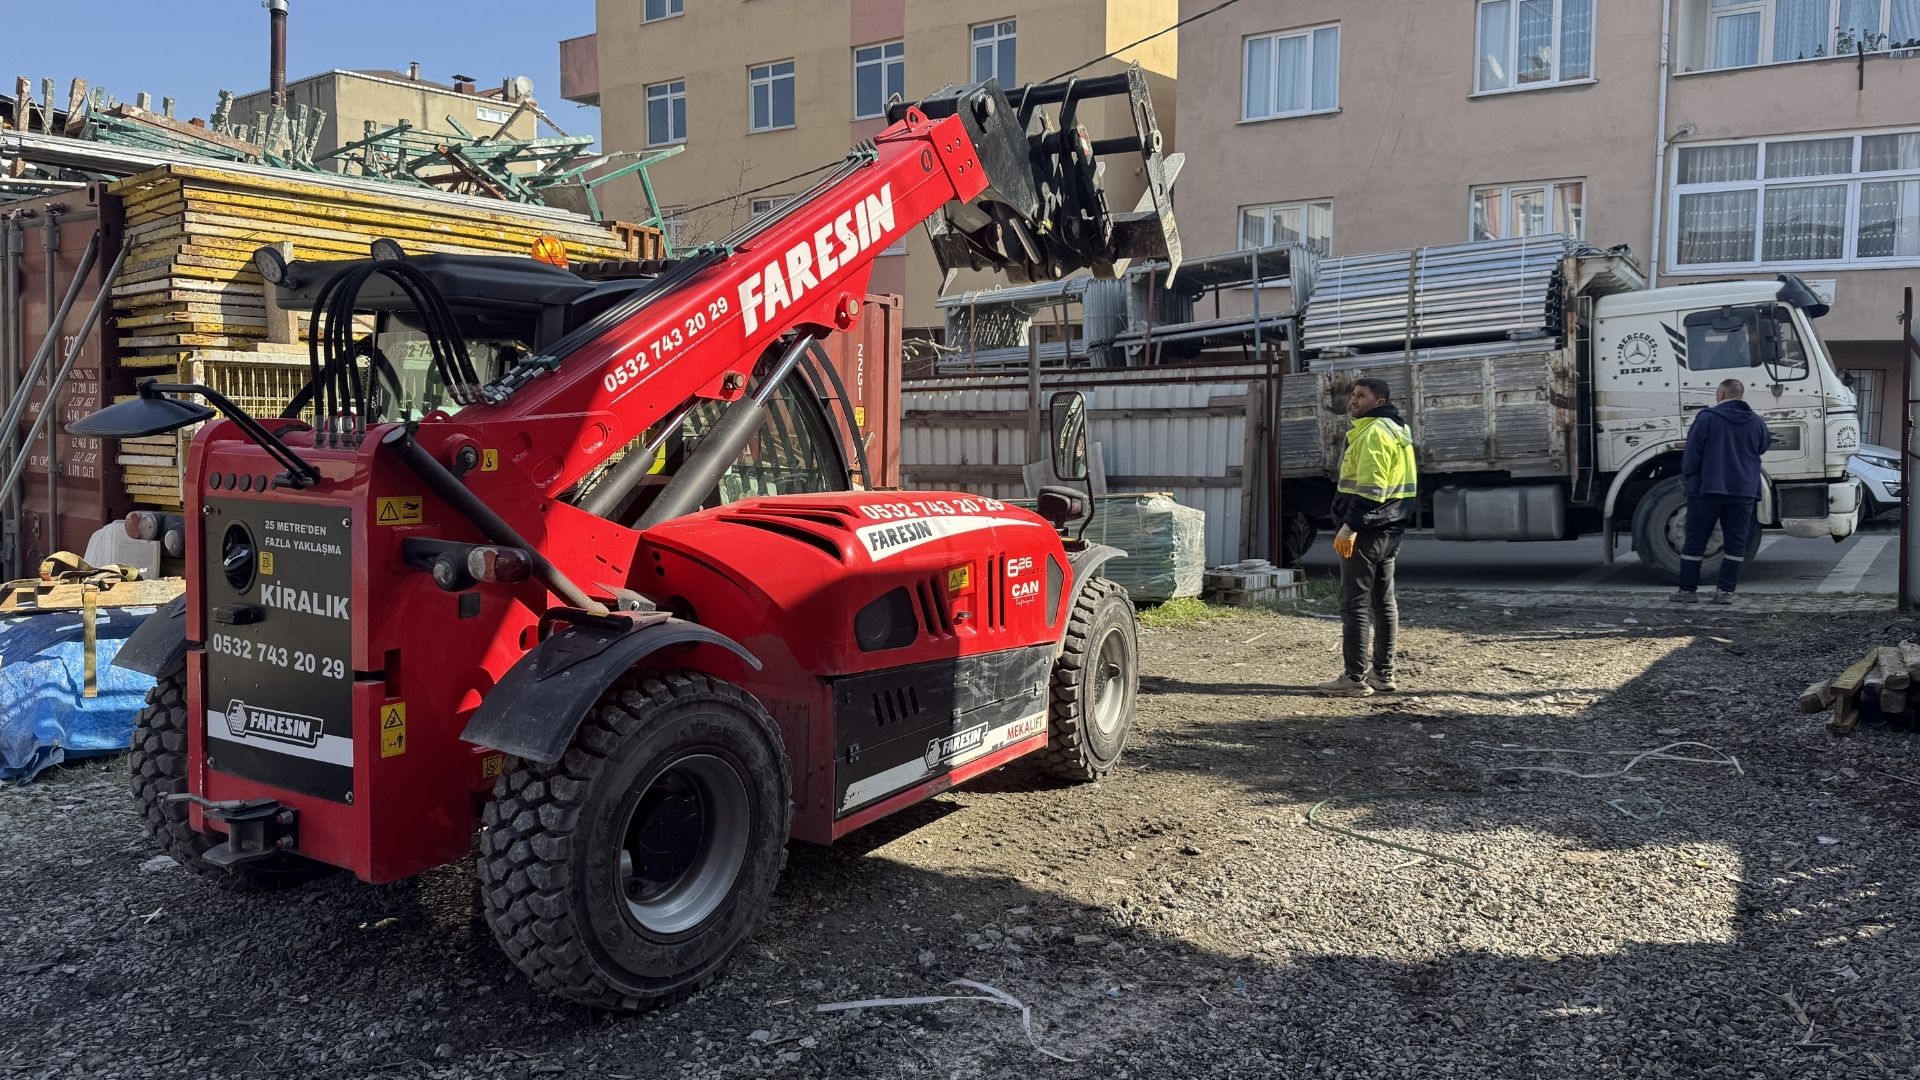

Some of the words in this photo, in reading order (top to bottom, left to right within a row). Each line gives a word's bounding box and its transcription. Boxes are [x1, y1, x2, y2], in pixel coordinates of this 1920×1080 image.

[738, 182, 896, 338] FARESIN
[64, 336, 84, 357] 221
[604, 351, 650, 393] 0532
[650, 328, 683, 360] 743
[685, 312, 706, 337] 20
[708, 296, 728, 321] 29
[1617, 333, 1658, 351] MERCEDES
[1620, 366, 1662, 375] BENZ
[859, 503, 918, 520] 0532
[913, 501, 955, 516] 743
[952, 498, 981, 513] 20
[978, 498, 1005, 511] 29
[265, 520, 275, 530] 25
[277, 521, 327, 536] METRE'DEN
[868, 520, 933, 551] FARESIN
[265, 537, 291, 549] FAZLA
[293, 540, 342, 556] YAKLAŞMA
[261, 580, 350, 620] KİRALIK
[1011, 580, 1039, 597] CAN
[213, 633, 252, 659] 0532
[257, 642, 288, 668] 743
[294, 651, 316, 673] 20
[322, 657, 345, 680] 29
[249, 711, 312, 738] FARESIN
[1007, 715, 1044, 740] MEKALIFT
[942, 727, 983, 756] FARESIN
